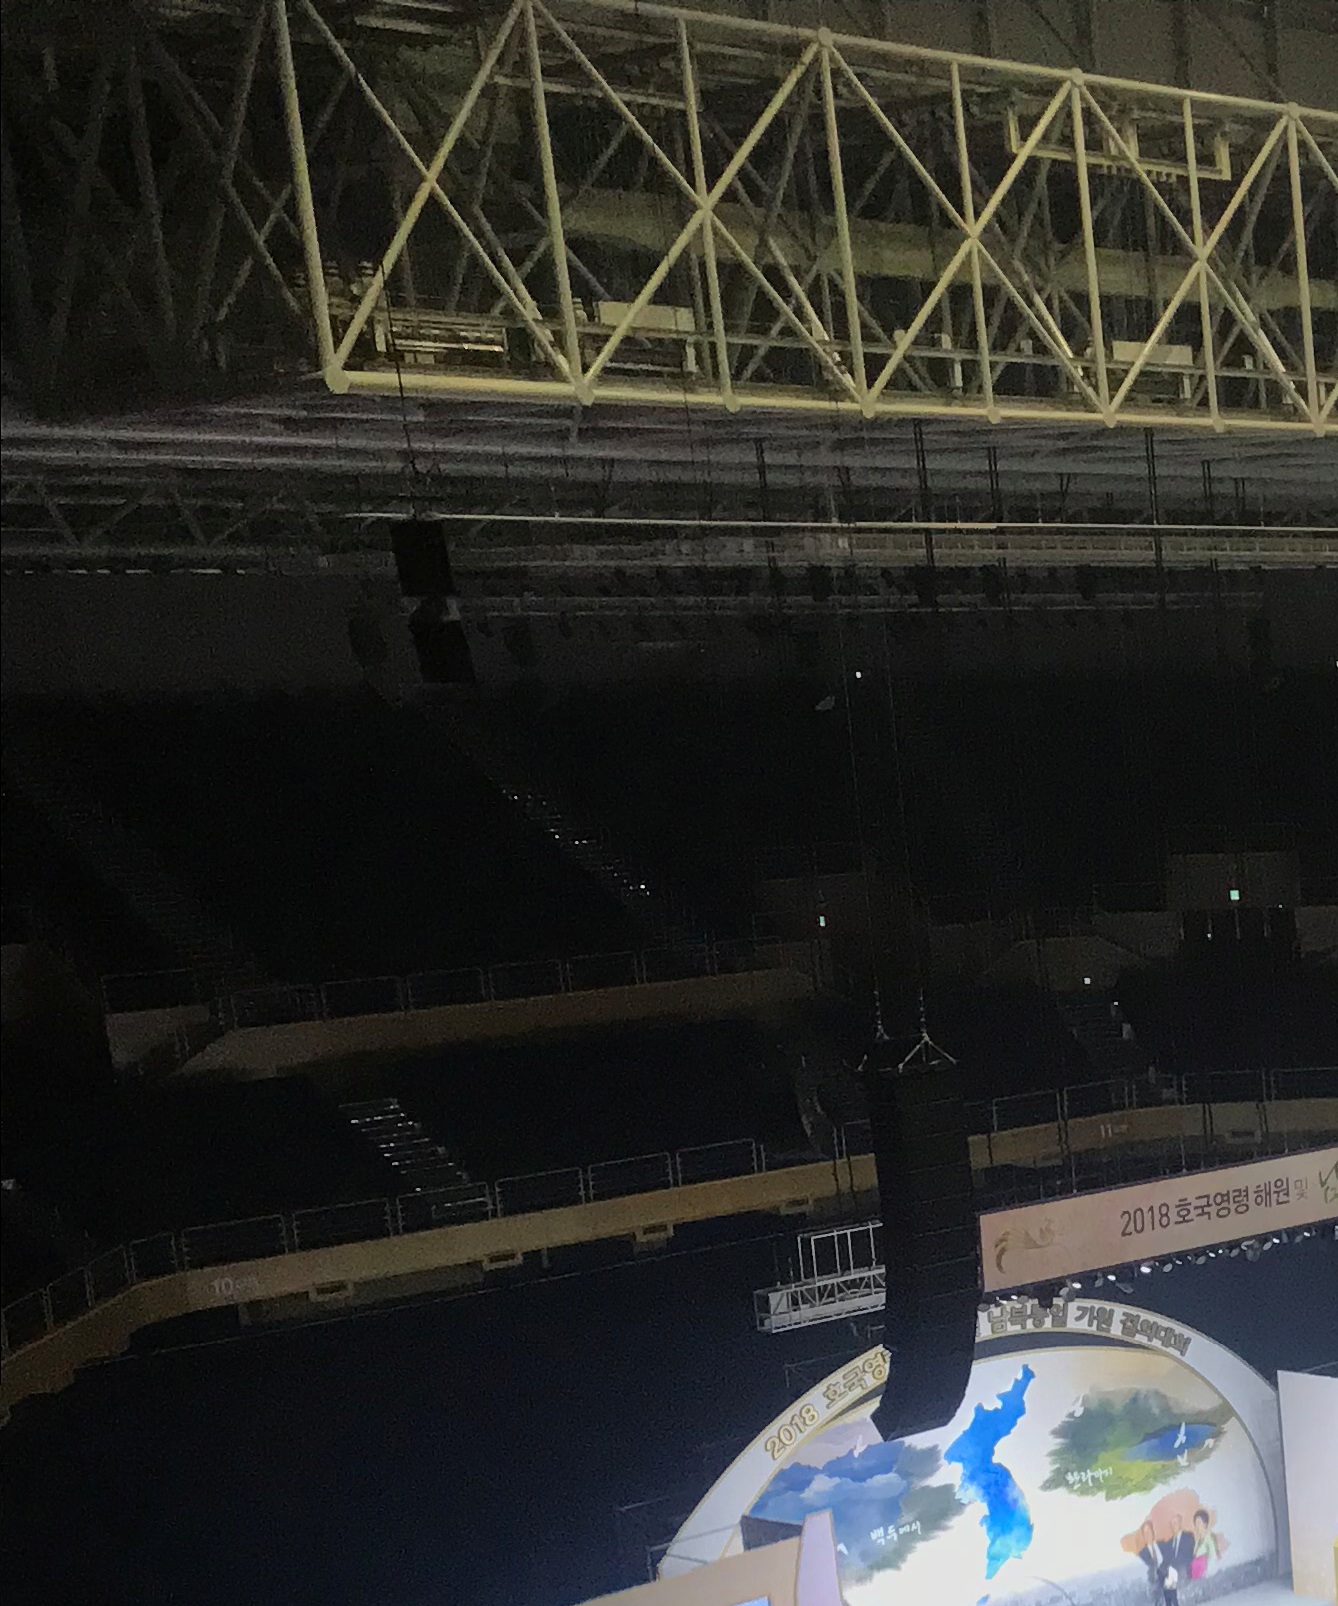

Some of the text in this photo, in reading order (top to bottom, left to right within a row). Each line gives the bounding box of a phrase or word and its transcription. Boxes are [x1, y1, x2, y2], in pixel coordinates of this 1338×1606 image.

[1120, 1202, 1171, 1238] 2018
[1174, 1185, 1249, 1226] 호국영령
[1253, 1176, 1291, 1208] 해원
[1074, 1305, 1115, 1332] 기원
[765, 1403, 820, 1461] 2018
